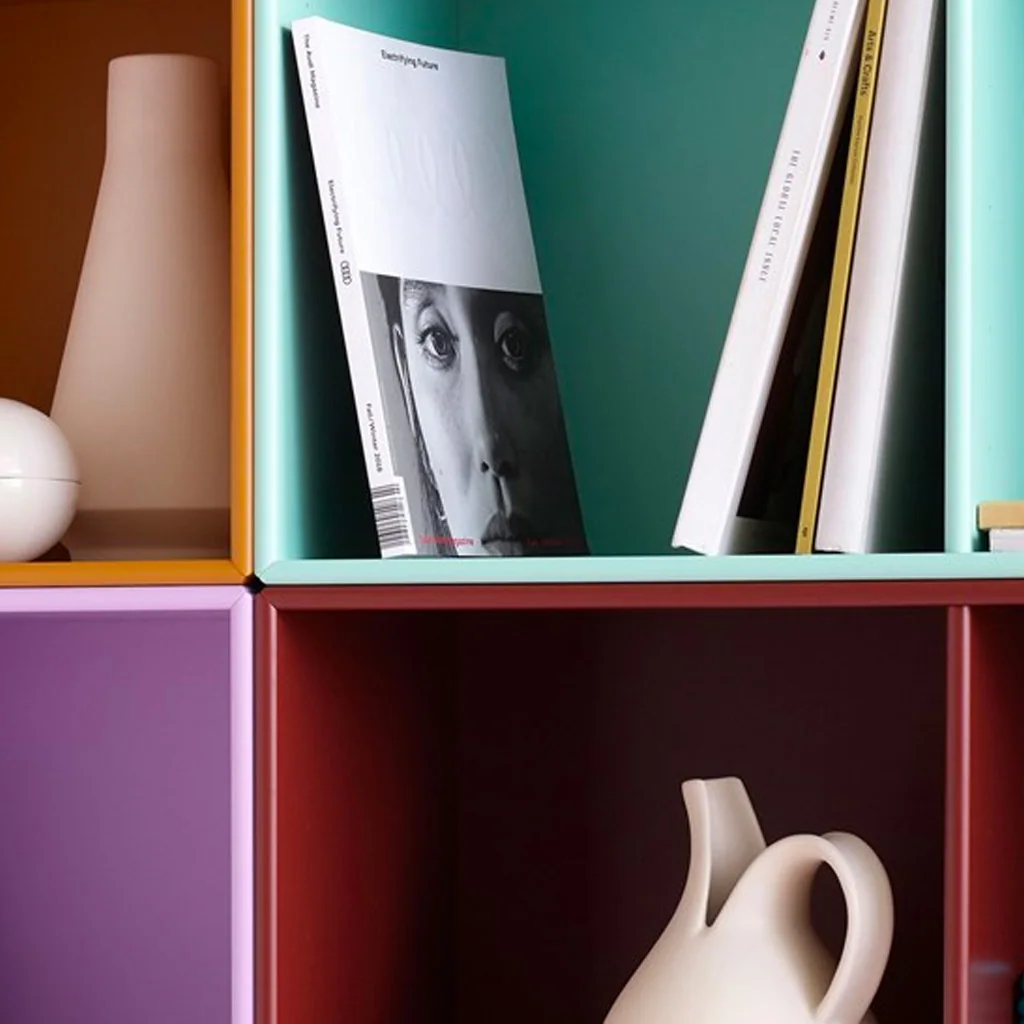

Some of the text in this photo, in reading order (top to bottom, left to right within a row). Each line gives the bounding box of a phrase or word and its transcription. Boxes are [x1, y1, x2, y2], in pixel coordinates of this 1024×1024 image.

[866, 30, 876, 51] Arts
[310, 70, 320, 108] Magazine
[860, 64, 872, 96] Crafts
[328, 179, 344, 254] Electrifying Future
